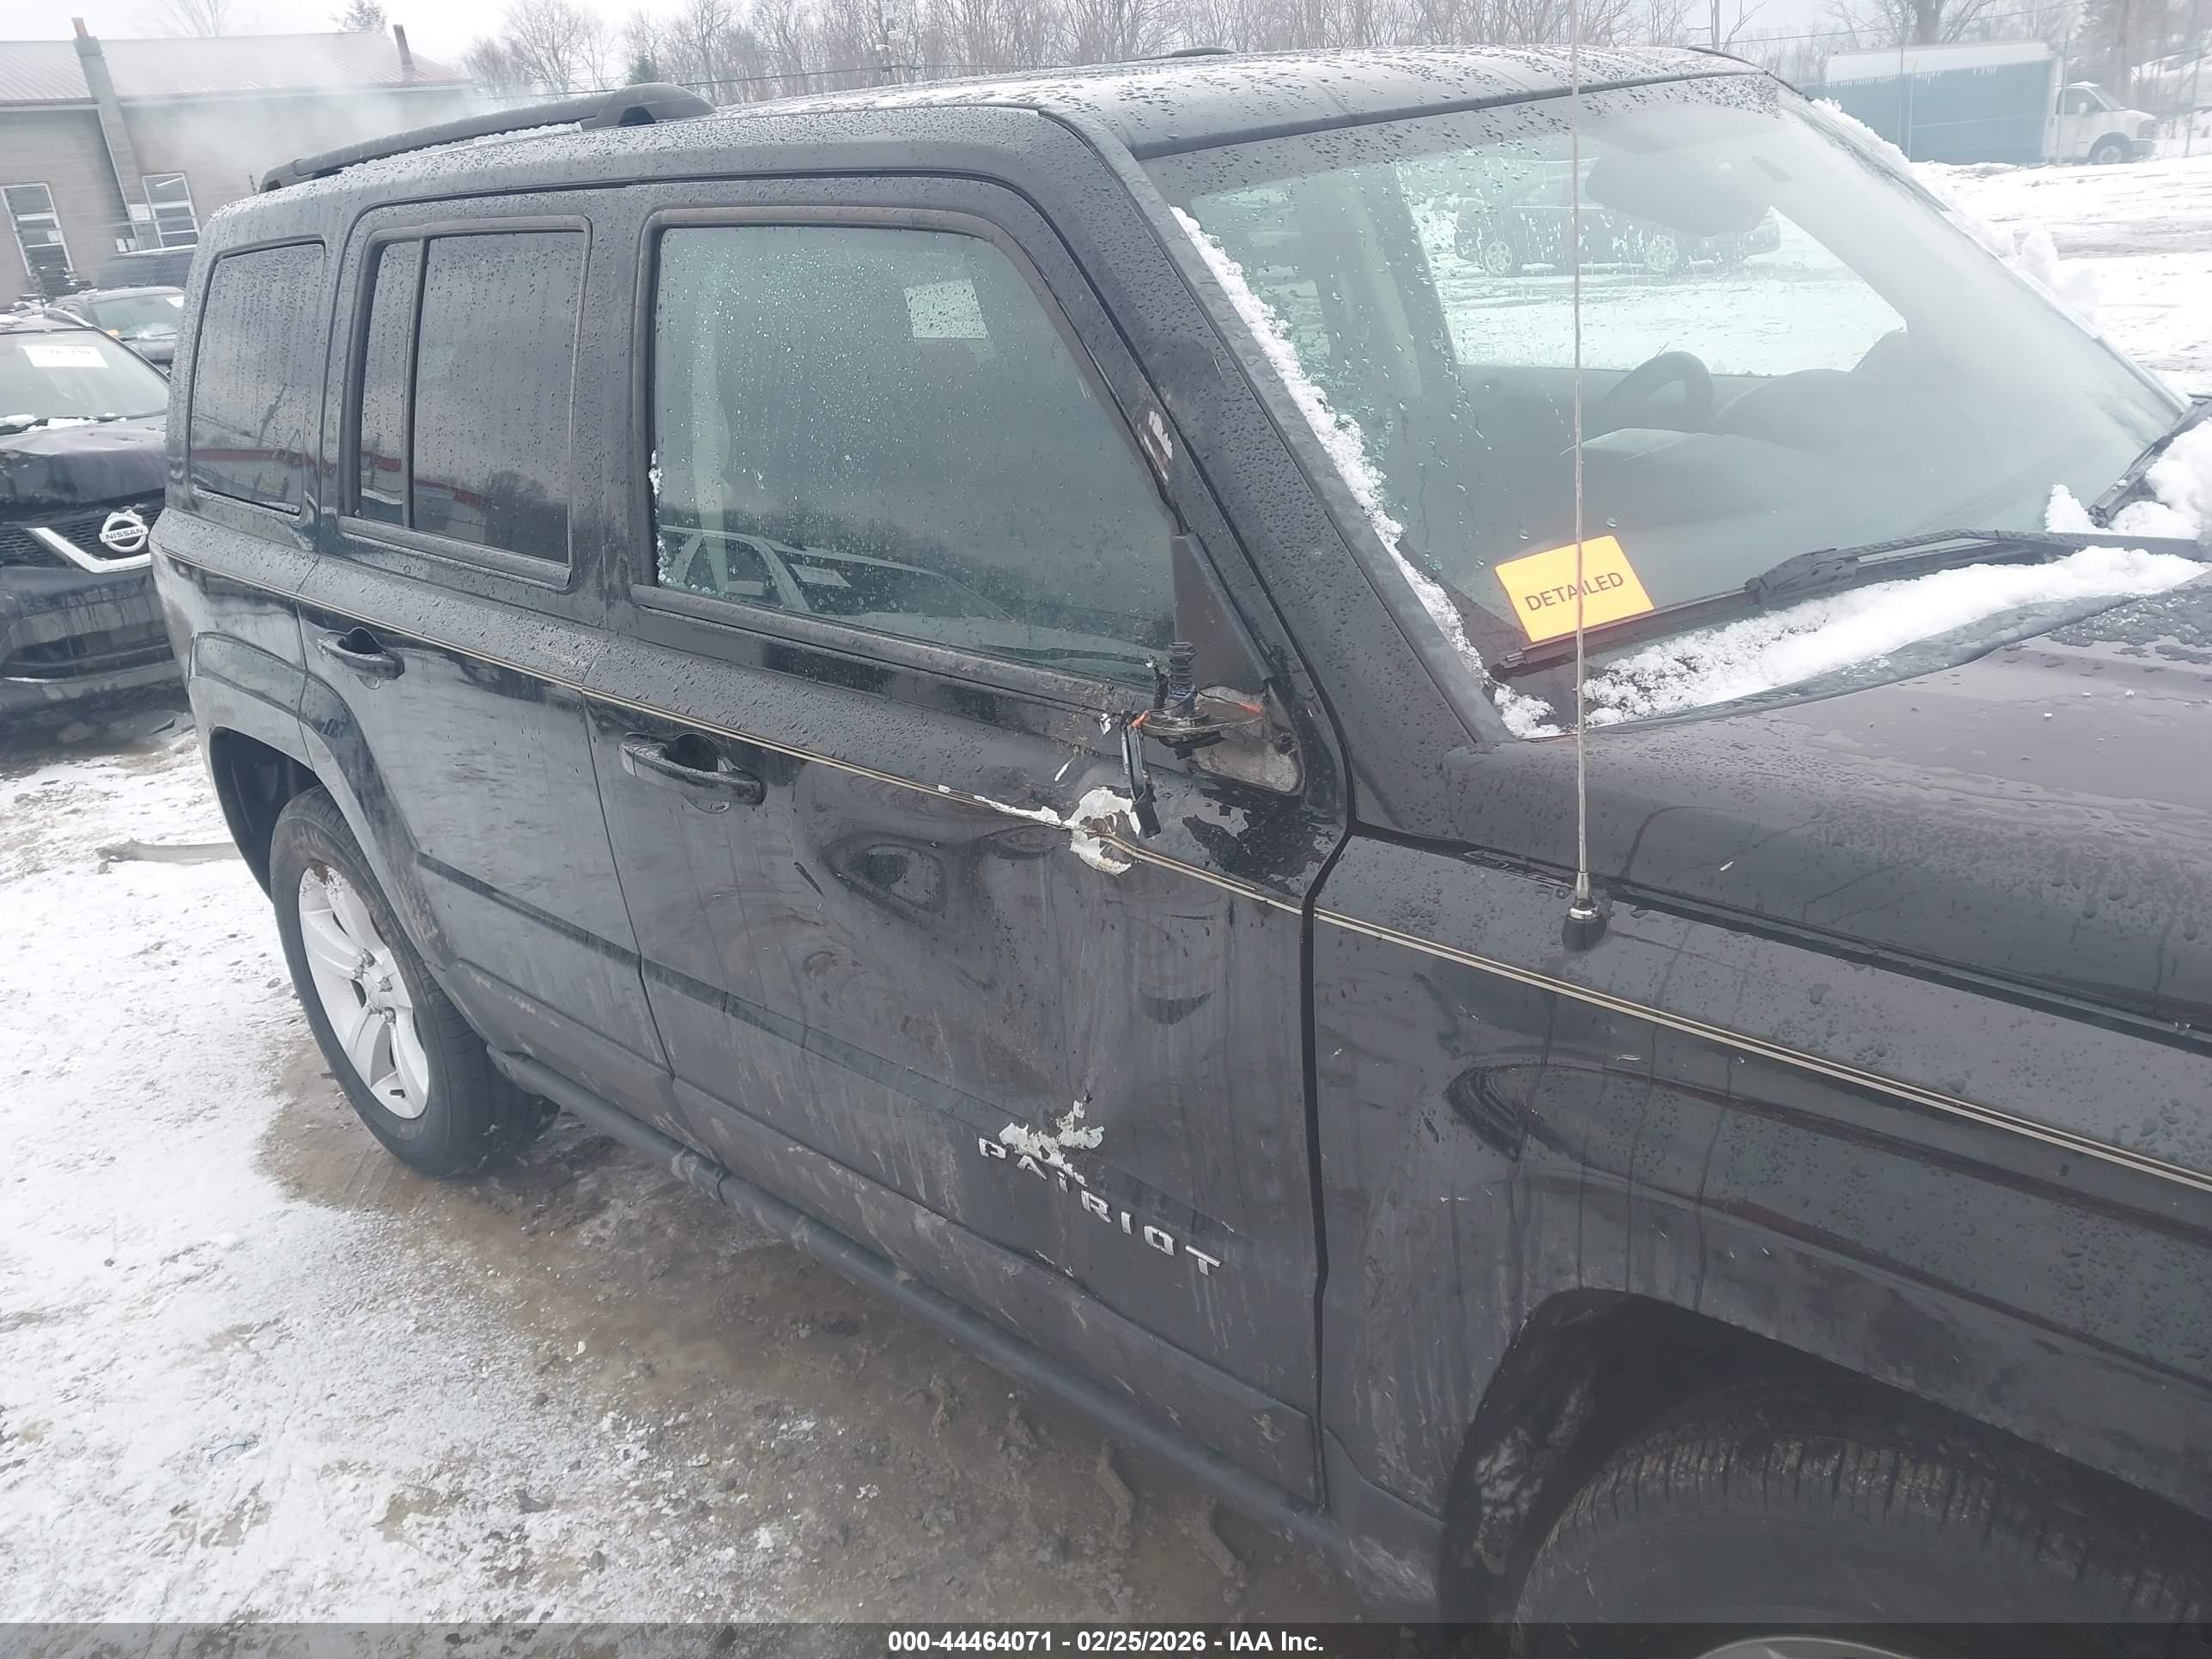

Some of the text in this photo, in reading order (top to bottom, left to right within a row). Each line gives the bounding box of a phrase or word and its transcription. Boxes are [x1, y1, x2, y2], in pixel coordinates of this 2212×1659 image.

[105, 528, 144, 540] NISSAN
[1524, 572, 1625, 611] DETAILED
[978, 1138, 1223, 1276] PATRIOT
